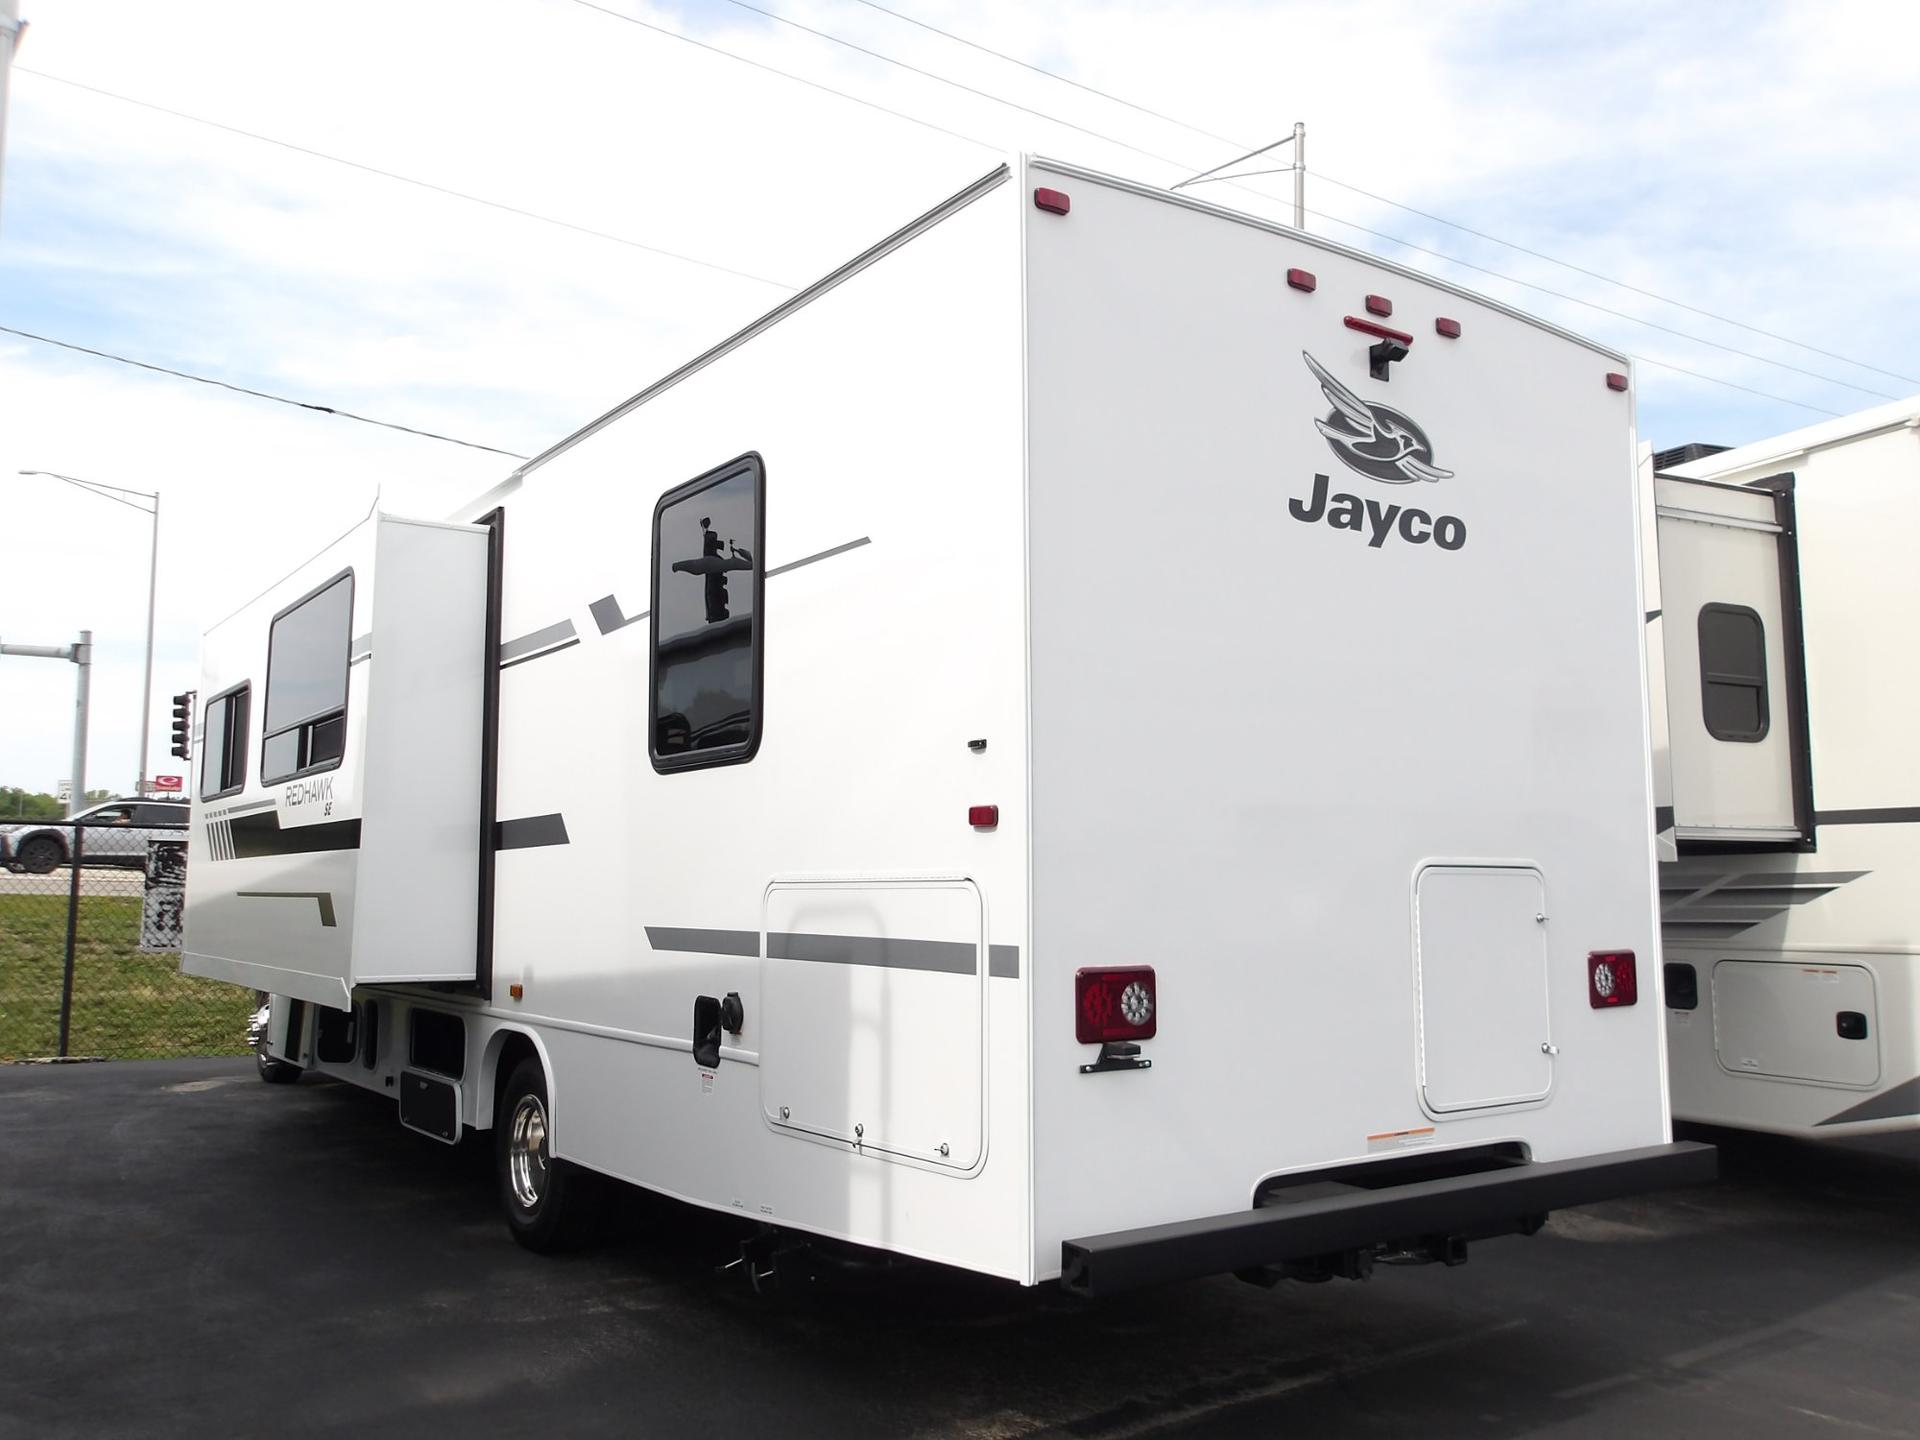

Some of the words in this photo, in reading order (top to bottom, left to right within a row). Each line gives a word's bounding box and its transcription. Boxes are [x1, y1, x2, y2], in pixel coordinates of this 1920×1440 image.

[1288, 473, 1467, 550] Jayco
[285, 776, 333, 807] REDHAWK
[324, 801, 333, 816] SE
